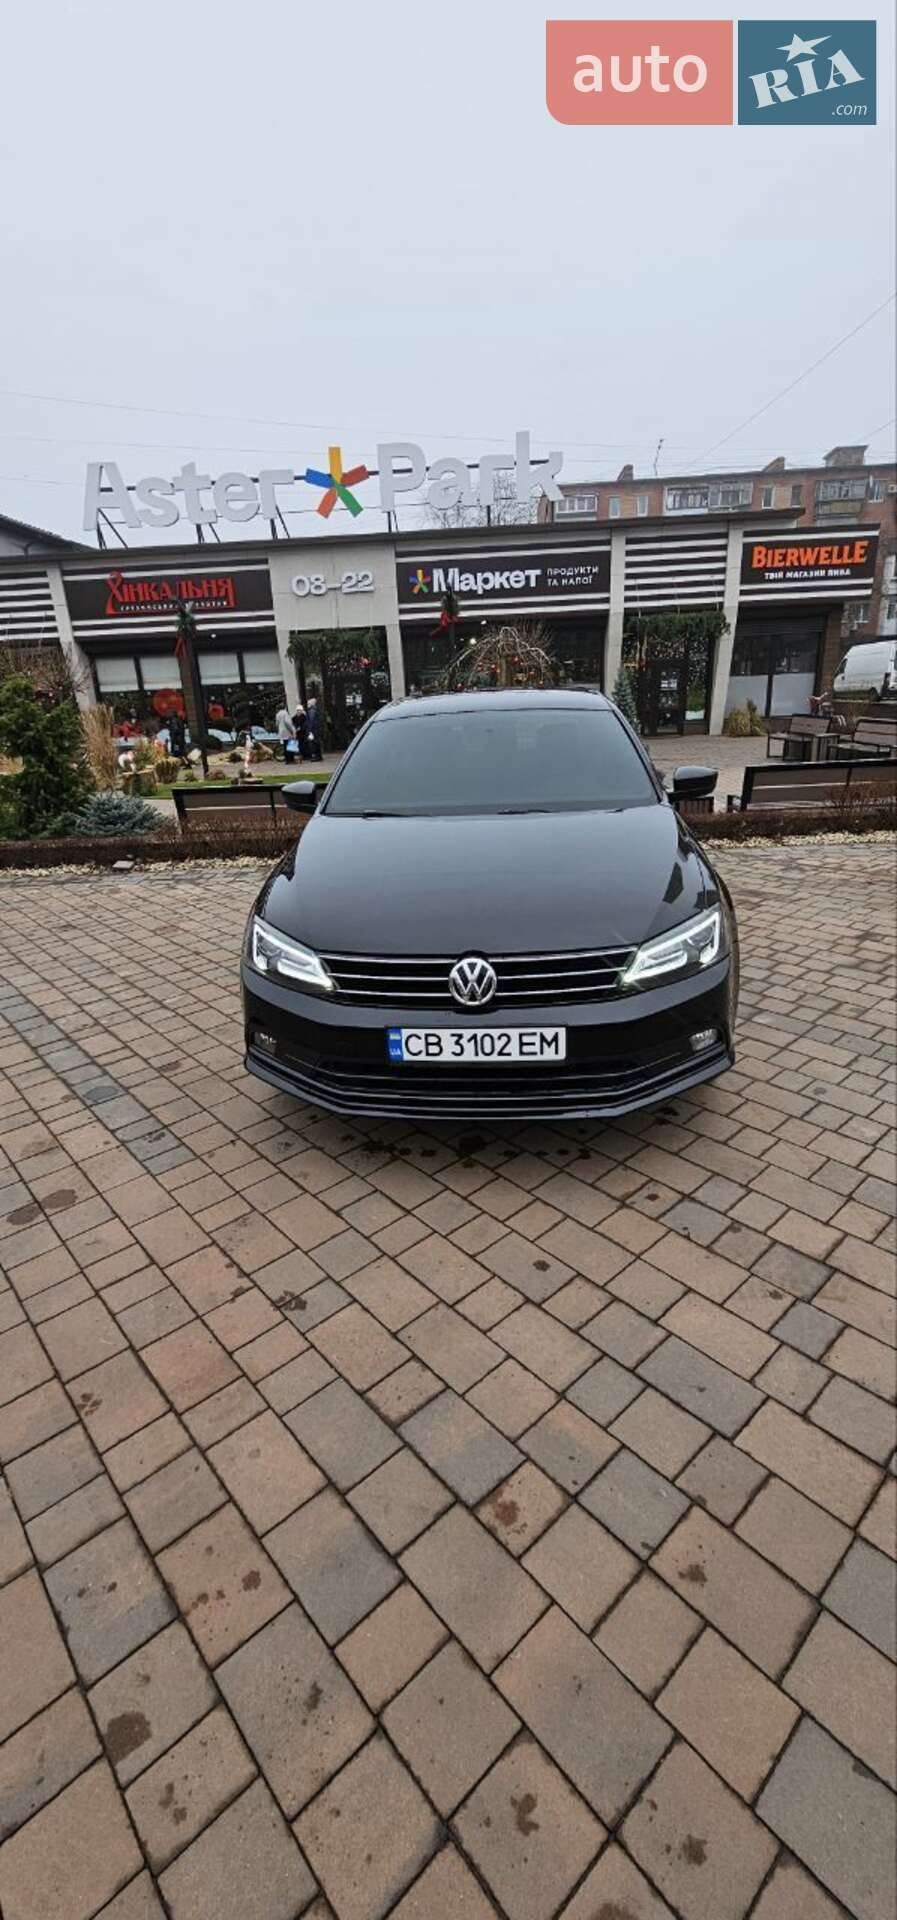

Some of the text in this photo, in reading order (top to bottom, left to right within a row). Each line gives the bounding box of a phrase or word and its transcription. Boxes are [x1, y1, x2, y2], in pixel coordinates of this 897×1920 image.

[83, 430, 564, 531] Aster Park
[752, 540, 869, 568] BIERWELLE
[432, 567, 542, 595] Маркет
[547, 565, 599, 577] ПРОДУКТИ
[547, 575, 594, 587] ТА НАПОЇ
[786, 569, 825, 579] МАГАЗИН
[404, 1031, 559, 1057] CB 3102 EM
